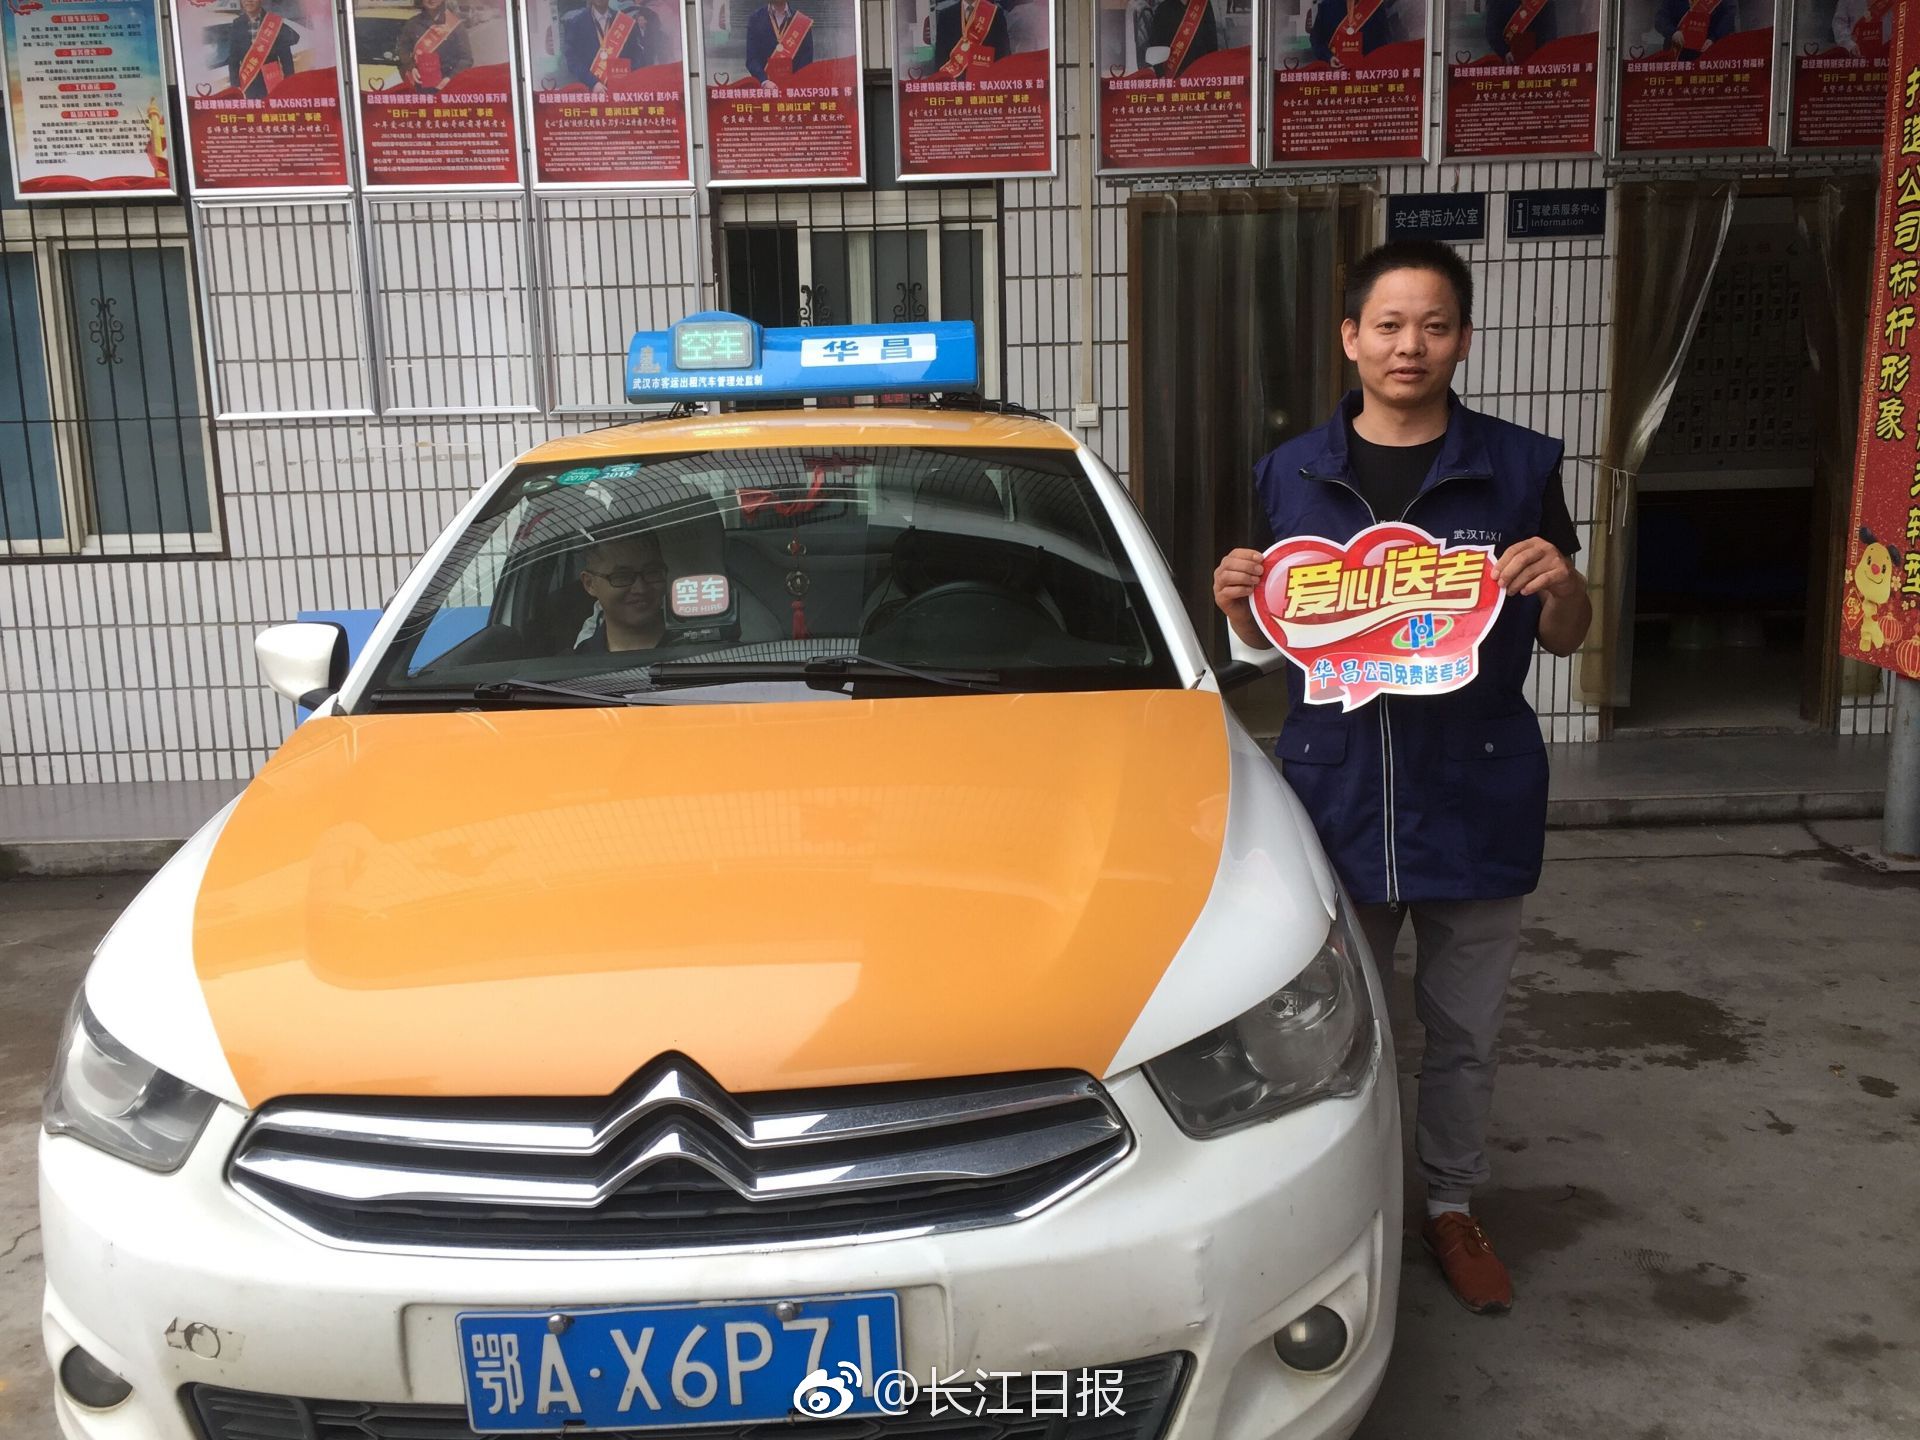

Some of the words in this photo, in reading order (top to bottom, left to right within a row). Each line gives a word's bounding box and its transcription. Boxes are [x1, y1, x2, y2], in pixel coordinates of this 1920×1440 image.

[1395, 208, 1479, 228] 安全营运办公室
[1531, 203, 1600, 217] 驾驶员服务中心
[1531, 217, 1584, 227] Information
[682, 329, 744, 361] 空车
[822, 338, 914, 363] 华昌
[632, 374, 763, 390] 武汉市客运出租汽车管理处监制
[602, 470, 635, 479] 2018
[675, 577, 724, 604] 空车
[1284, 545, 1486, 619] 爱心送考
[678, 605, 699, 613] FOR
[1311, 656, 1470, 688] 华昌公司免费送考车
